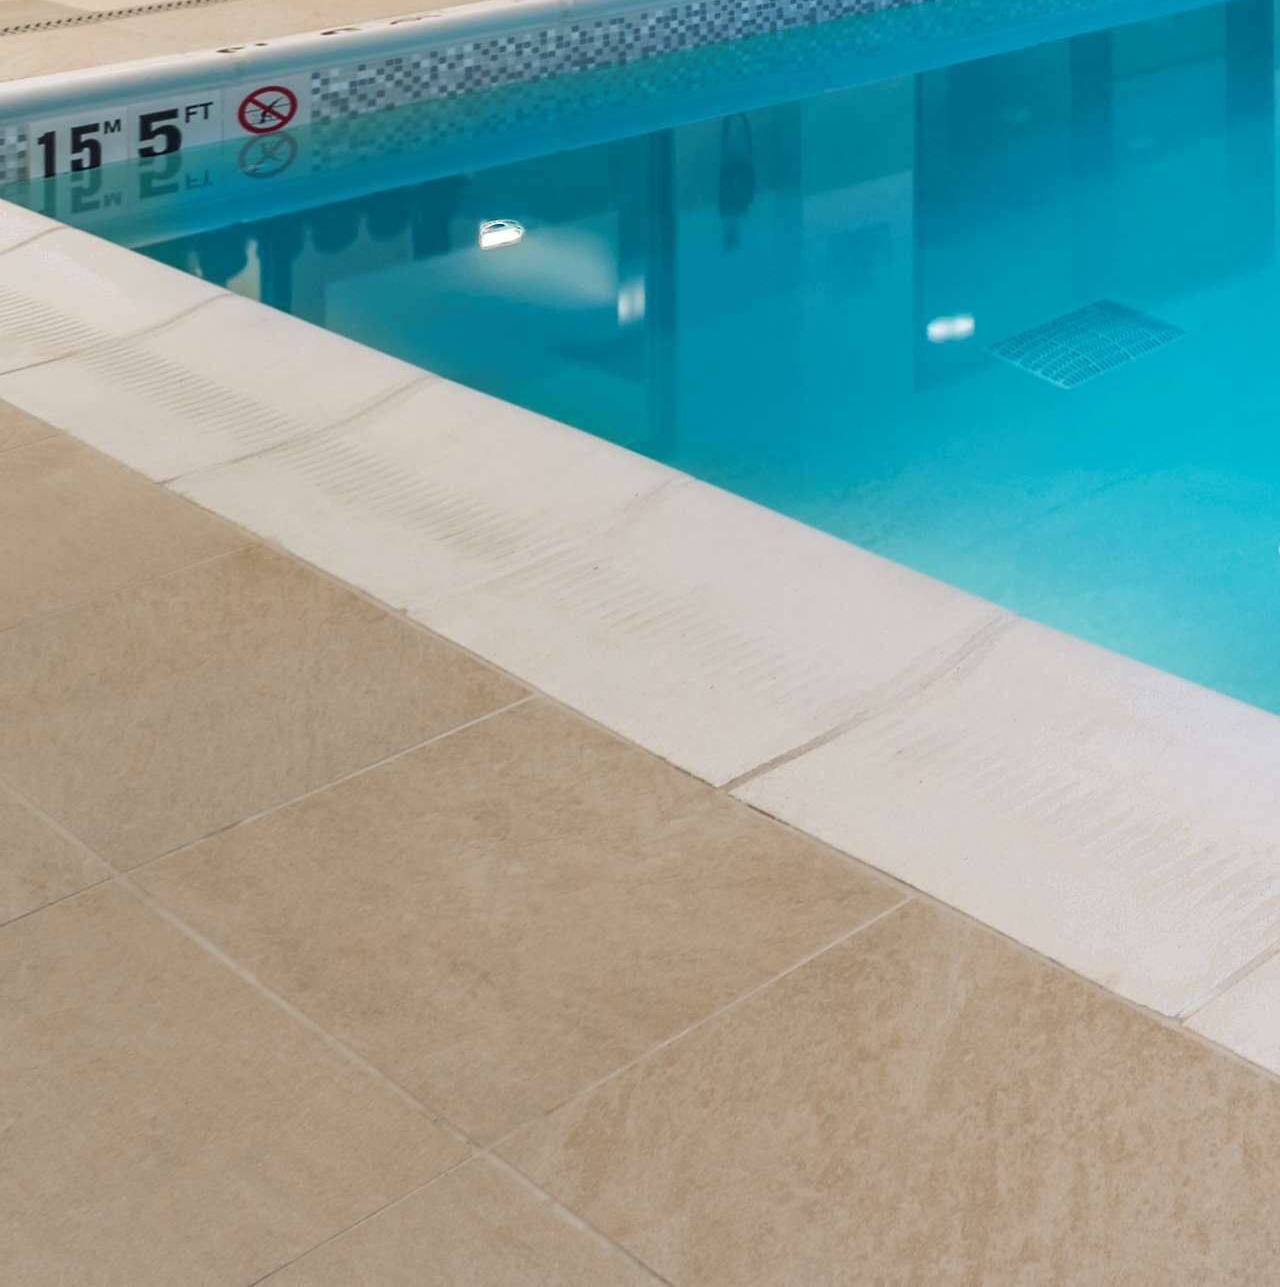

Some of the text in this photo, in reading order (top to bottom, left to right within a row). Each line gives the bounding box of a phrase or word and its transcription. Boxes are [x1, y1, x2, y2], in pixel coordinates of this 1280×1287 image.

[103, 118, 122, 135] M
[138, 107, 183, 158] 5
[184, 101, 214, 123] FT
